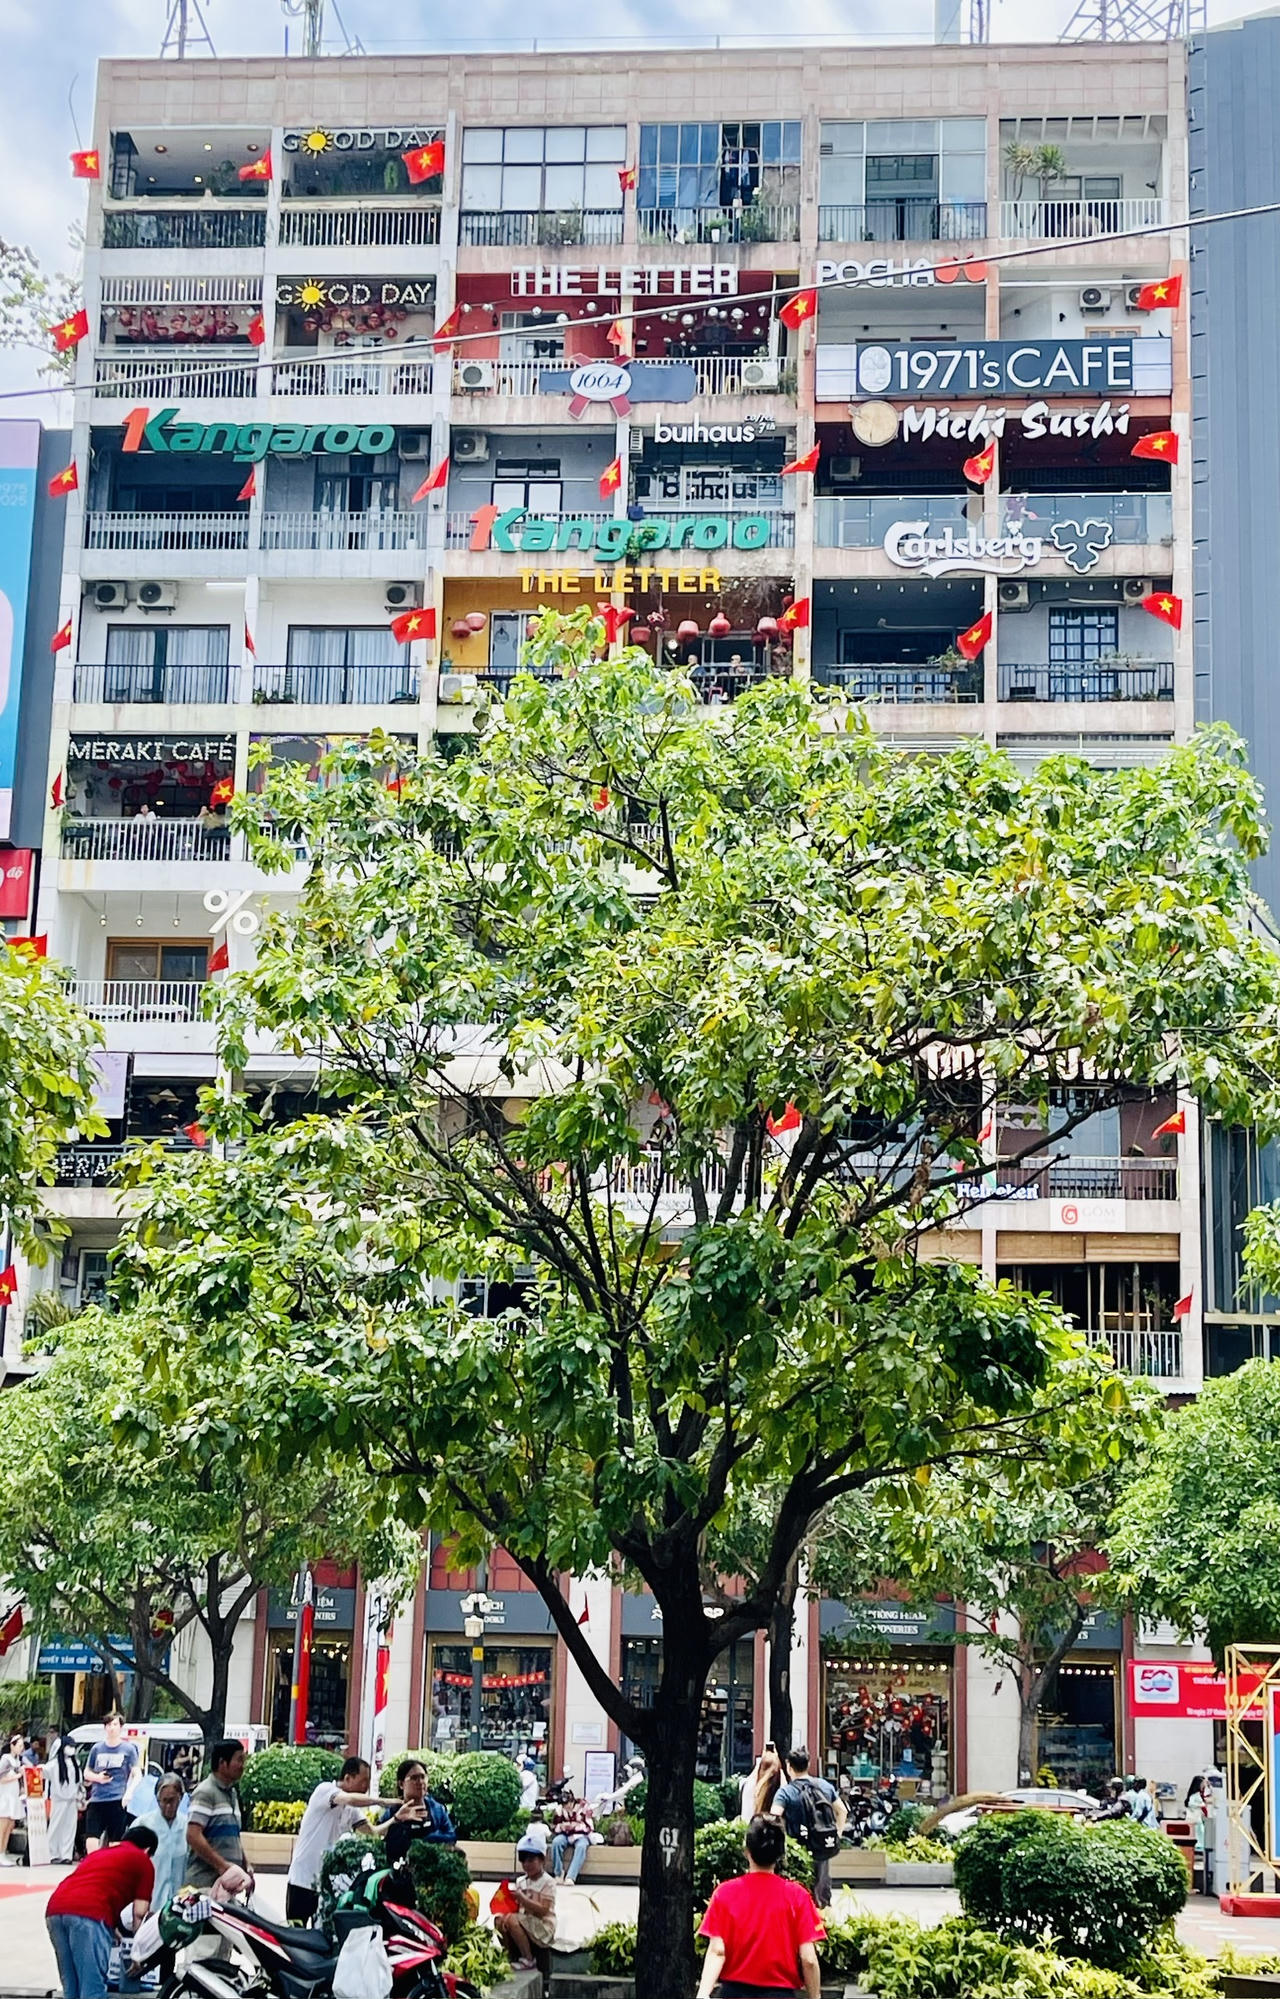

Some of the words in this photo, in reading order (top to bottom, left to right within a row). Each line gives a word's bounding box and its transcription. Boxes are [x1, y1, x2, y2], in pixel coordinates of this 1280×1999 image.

[385, 129, 438, 149] DAY
[511, 264, 582, 295] THE
[597, 264, 738, 295] LETTER
[381, 283, 431, 304] DAY
[577, 373, 623, 388] 1664
[894, 350, 1000, 389] 1971's
[1006, 346, 1131, 388] CAFE
[903, 404, 1006, 442] Michi
[1021, 401, 1130, 440] Sushi
[884, 521, 1042, 573] Carlsberg
[517, 567, 581, 593] THE
[594, 567, 720, 593] LETTER
[68, 740, 163, 760] MERAKI
[172, 734, 233, 760] CAFÉ
